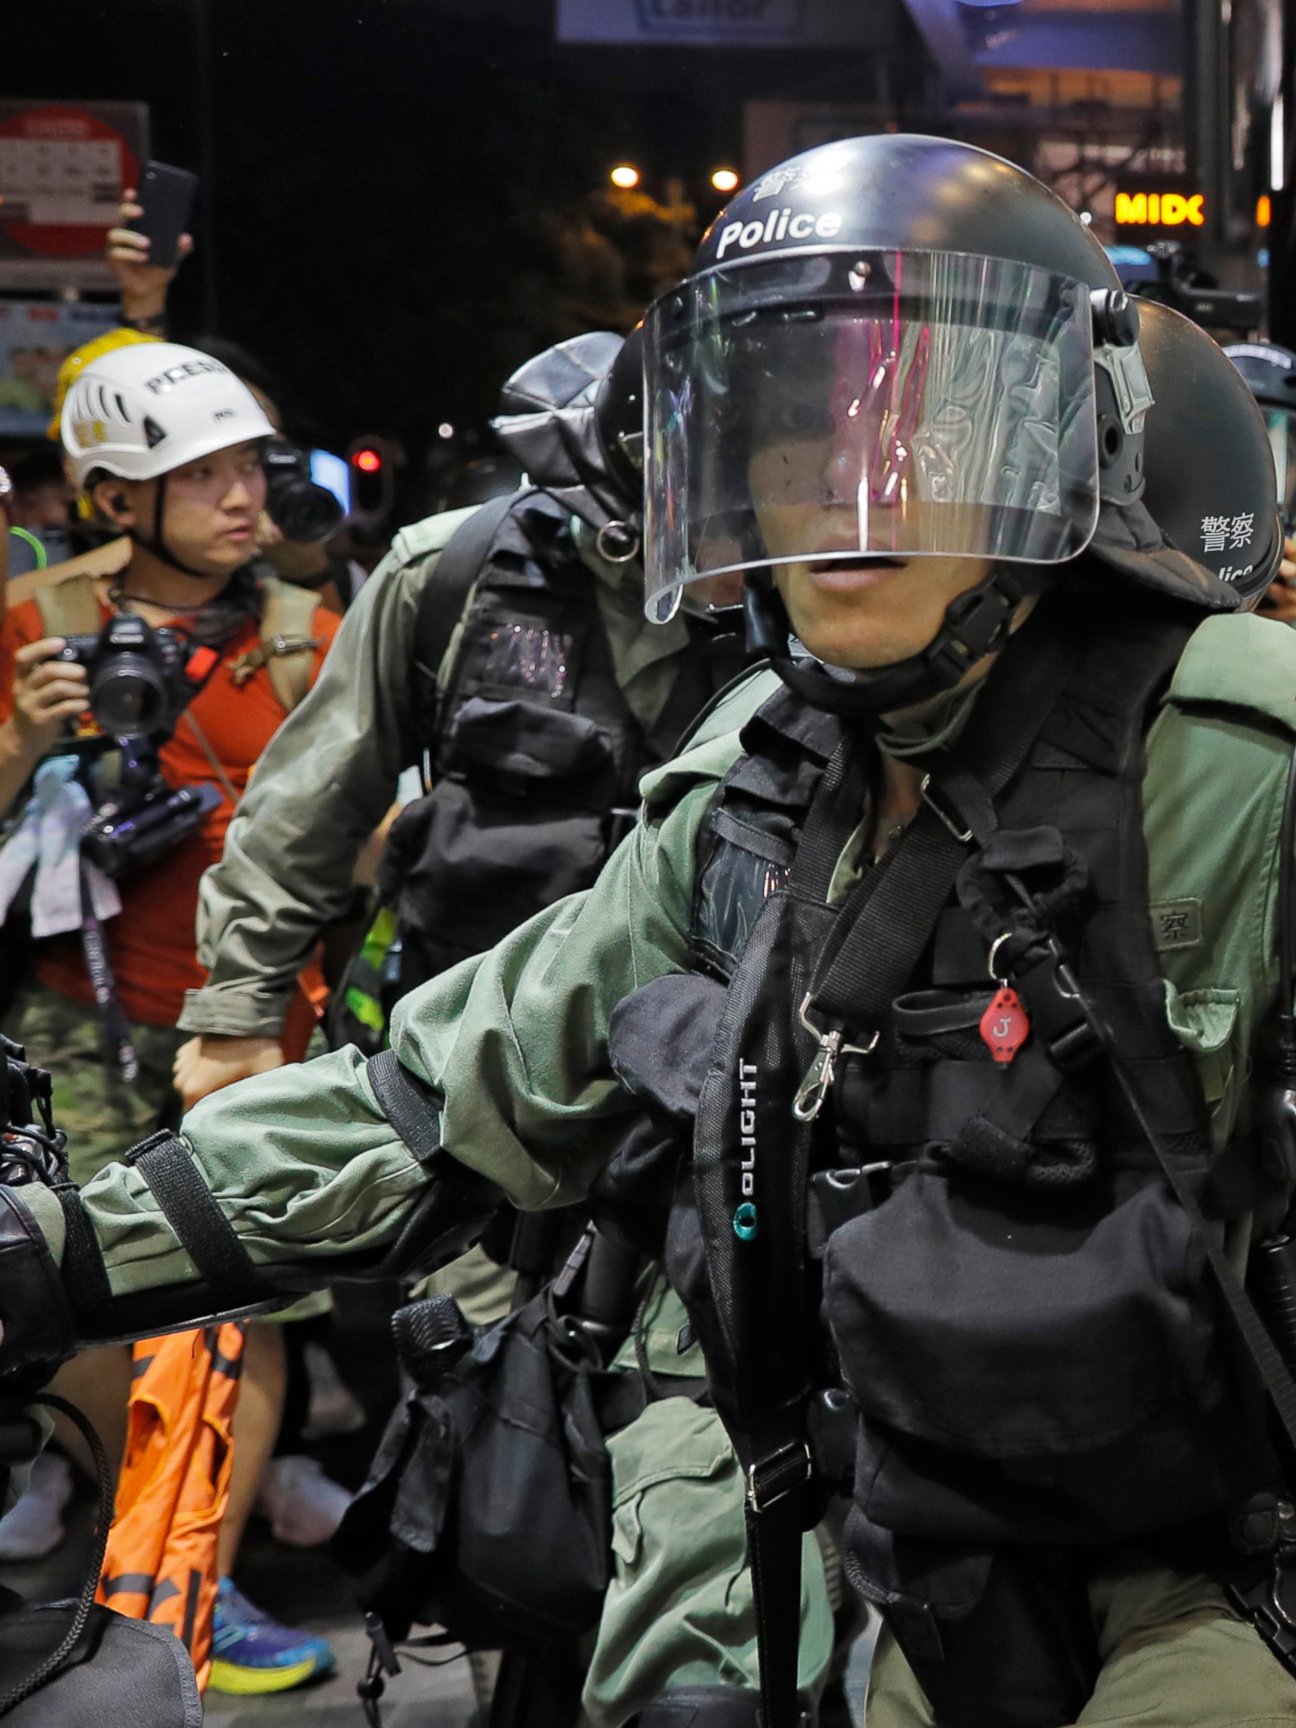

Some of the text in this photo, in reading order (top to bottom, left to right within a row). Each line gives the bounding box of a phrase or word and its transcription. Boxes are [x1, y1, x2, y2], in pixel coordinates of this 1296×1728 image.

[716, 208, 842, 259] Police
[1200, 512, 1255, 553] 警察
[1160, 910, 1189, 941] 察
[739, 1057, 758, 1197] OLIGHT
